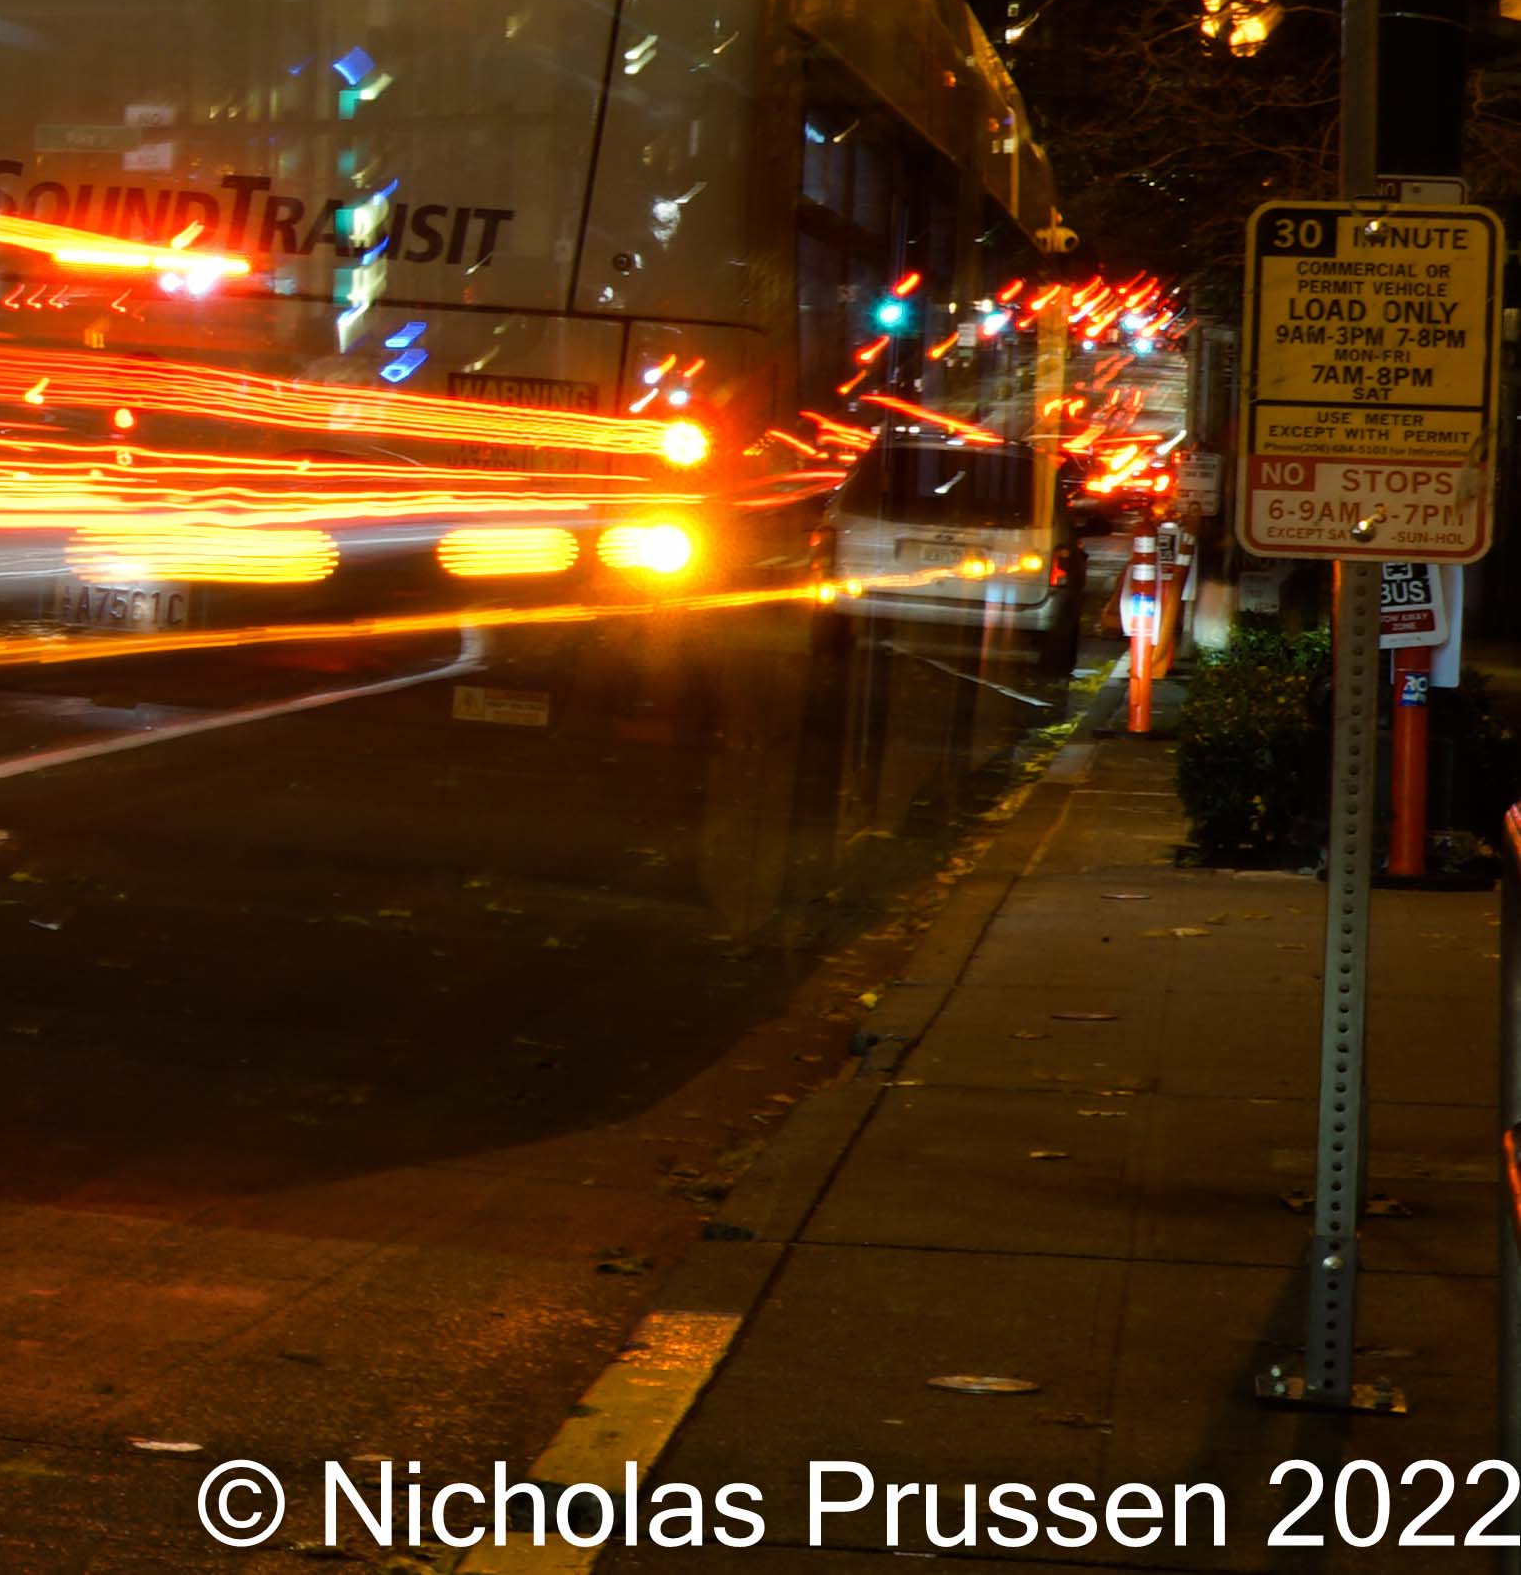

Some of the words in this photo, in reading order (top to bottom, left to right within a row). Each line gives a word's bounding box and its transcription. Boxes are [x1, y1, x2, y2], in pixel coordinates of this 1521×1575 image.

[1273, 219, 1323, 249] 30
[1297, 262, 1419, 278] COMMERCIAL
[1426, 264, 1451, 278] OR
[1298, 280, 1365, 296] PERMIT
[1373, 282, 1447, 298] VEHICLE
[1289, 299, 1367, 323] LOAD
[1383, 301, 1459, 325] ONLY
[1276, 325, 1384, 347] 9AM-3PM
[1396, 328, 1466, 349] 7-8PM
[1334, 349, 1412, 364] MON-FRI
[1311, 364, 1434, 387] 7AM-8PM
[1352, 387, 1393, 401] SAT
[1317, 412, 1350, 425] USE
[1365, 413, 1425, 427] METER
[1268, 425, 1335, 439] EXCEPT
[1345, 428, 1390, 441] WITH
[1403, 429, 1471, 444] PERMIT
[1261, 462, 1305, 486] NO
[1342, 469, 1454, 496] STOPS
[1269, 500, 1361, 524] 6-9AM
[1374, 502, 1464, 527] 3-7PM
[1267, 527, 1323, 540] EXCEPT
[1328, 527, 1353, 540] SA
[1381, 580, 1426, 605] BUS
